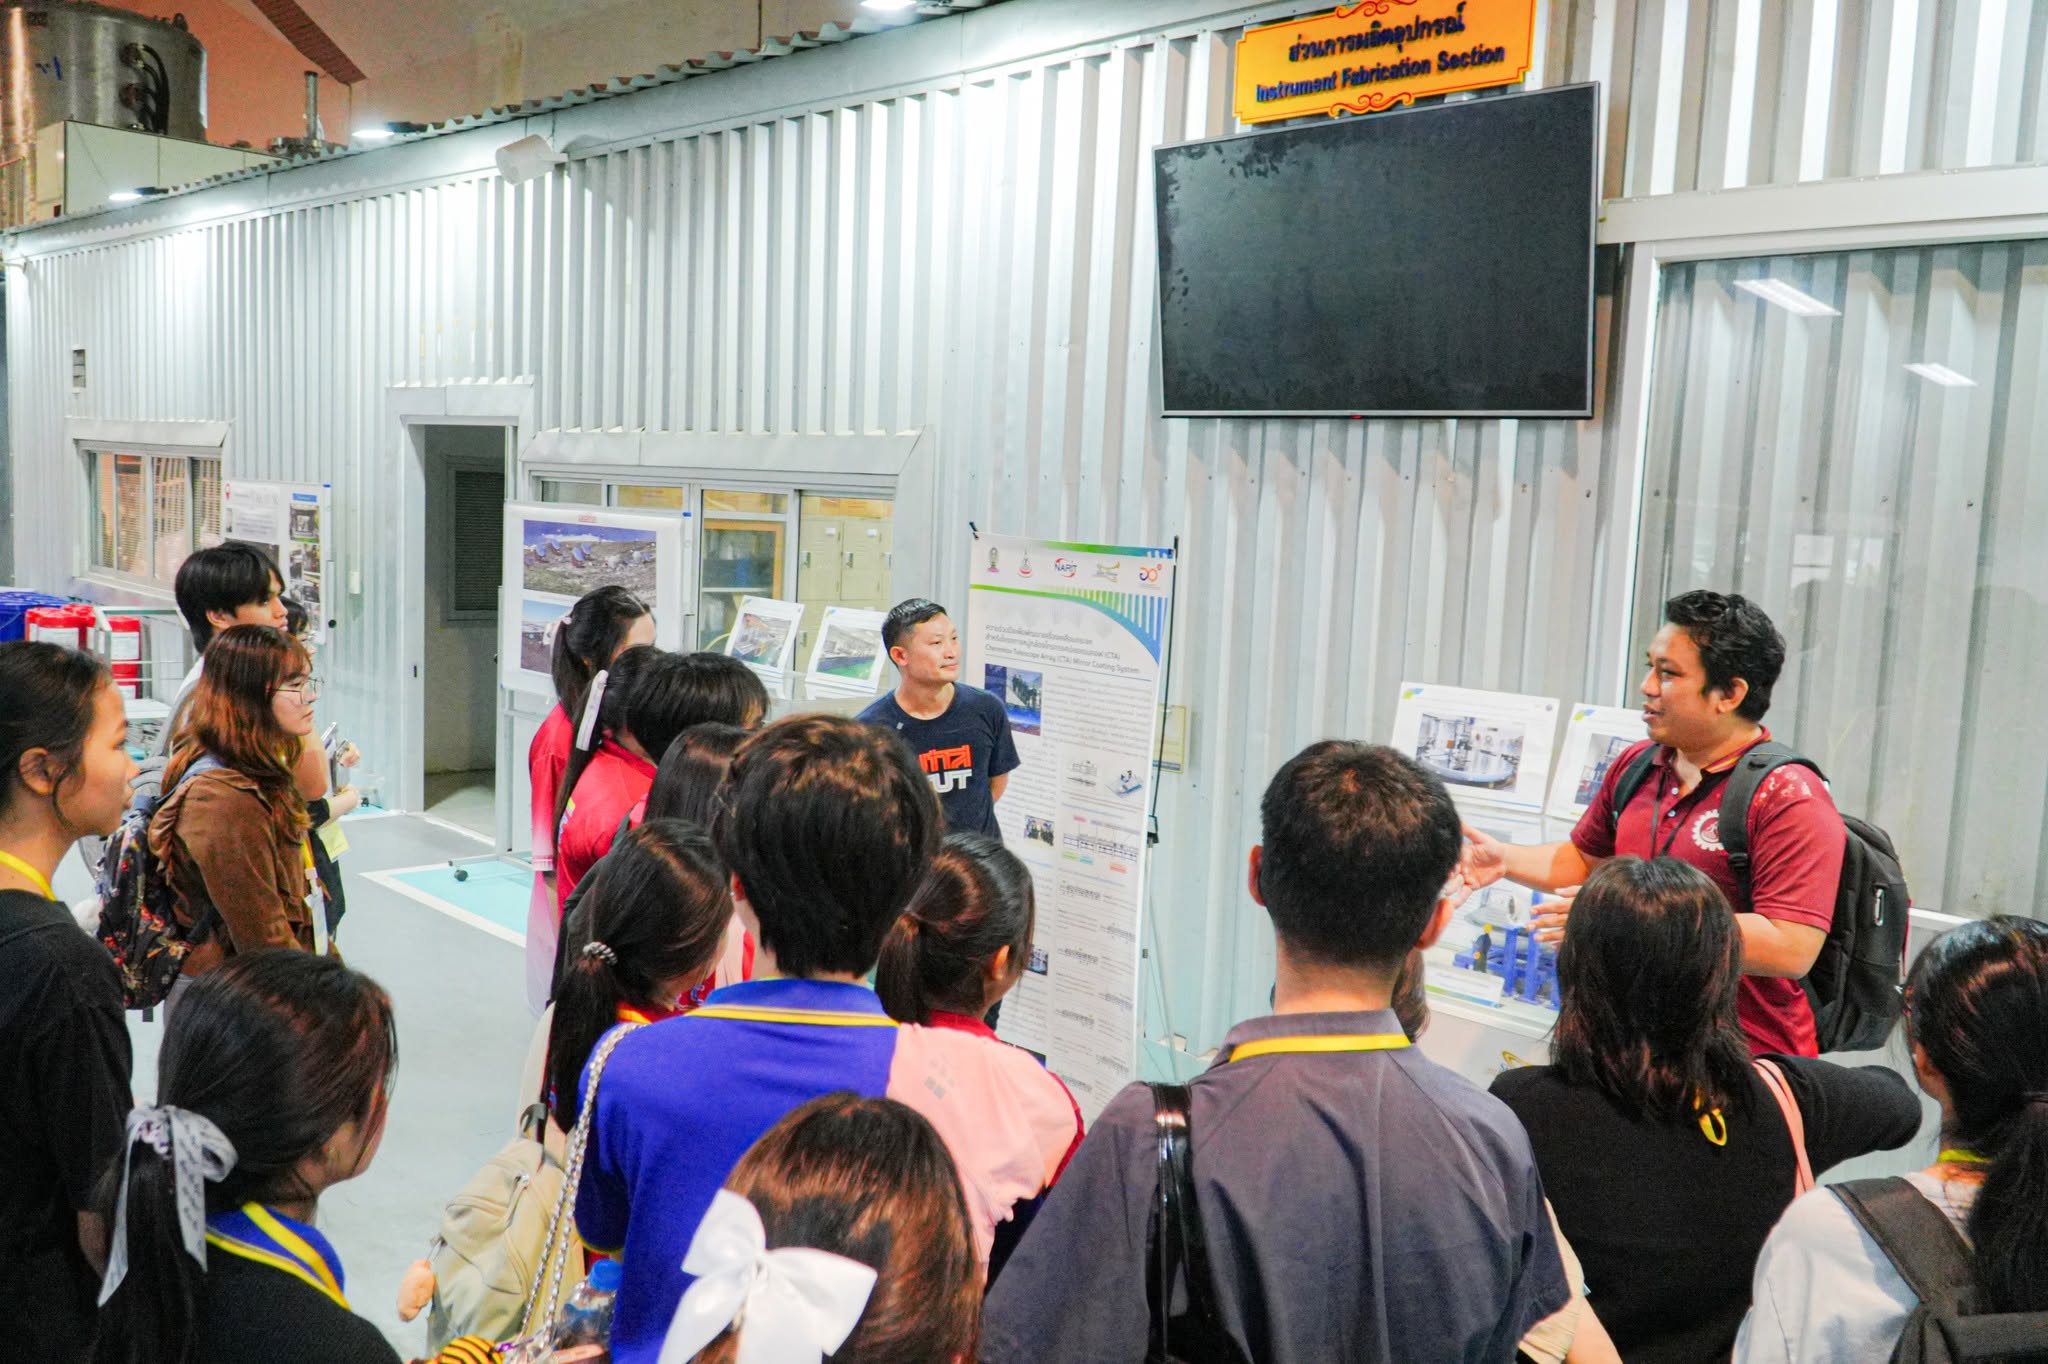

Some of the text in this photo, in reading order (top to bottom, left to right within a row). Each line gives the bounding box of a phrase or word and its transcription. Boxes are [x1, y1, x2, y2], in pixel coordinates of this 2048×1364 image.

[1256, 44, 1506, 101] Instrument Fabrication Section
